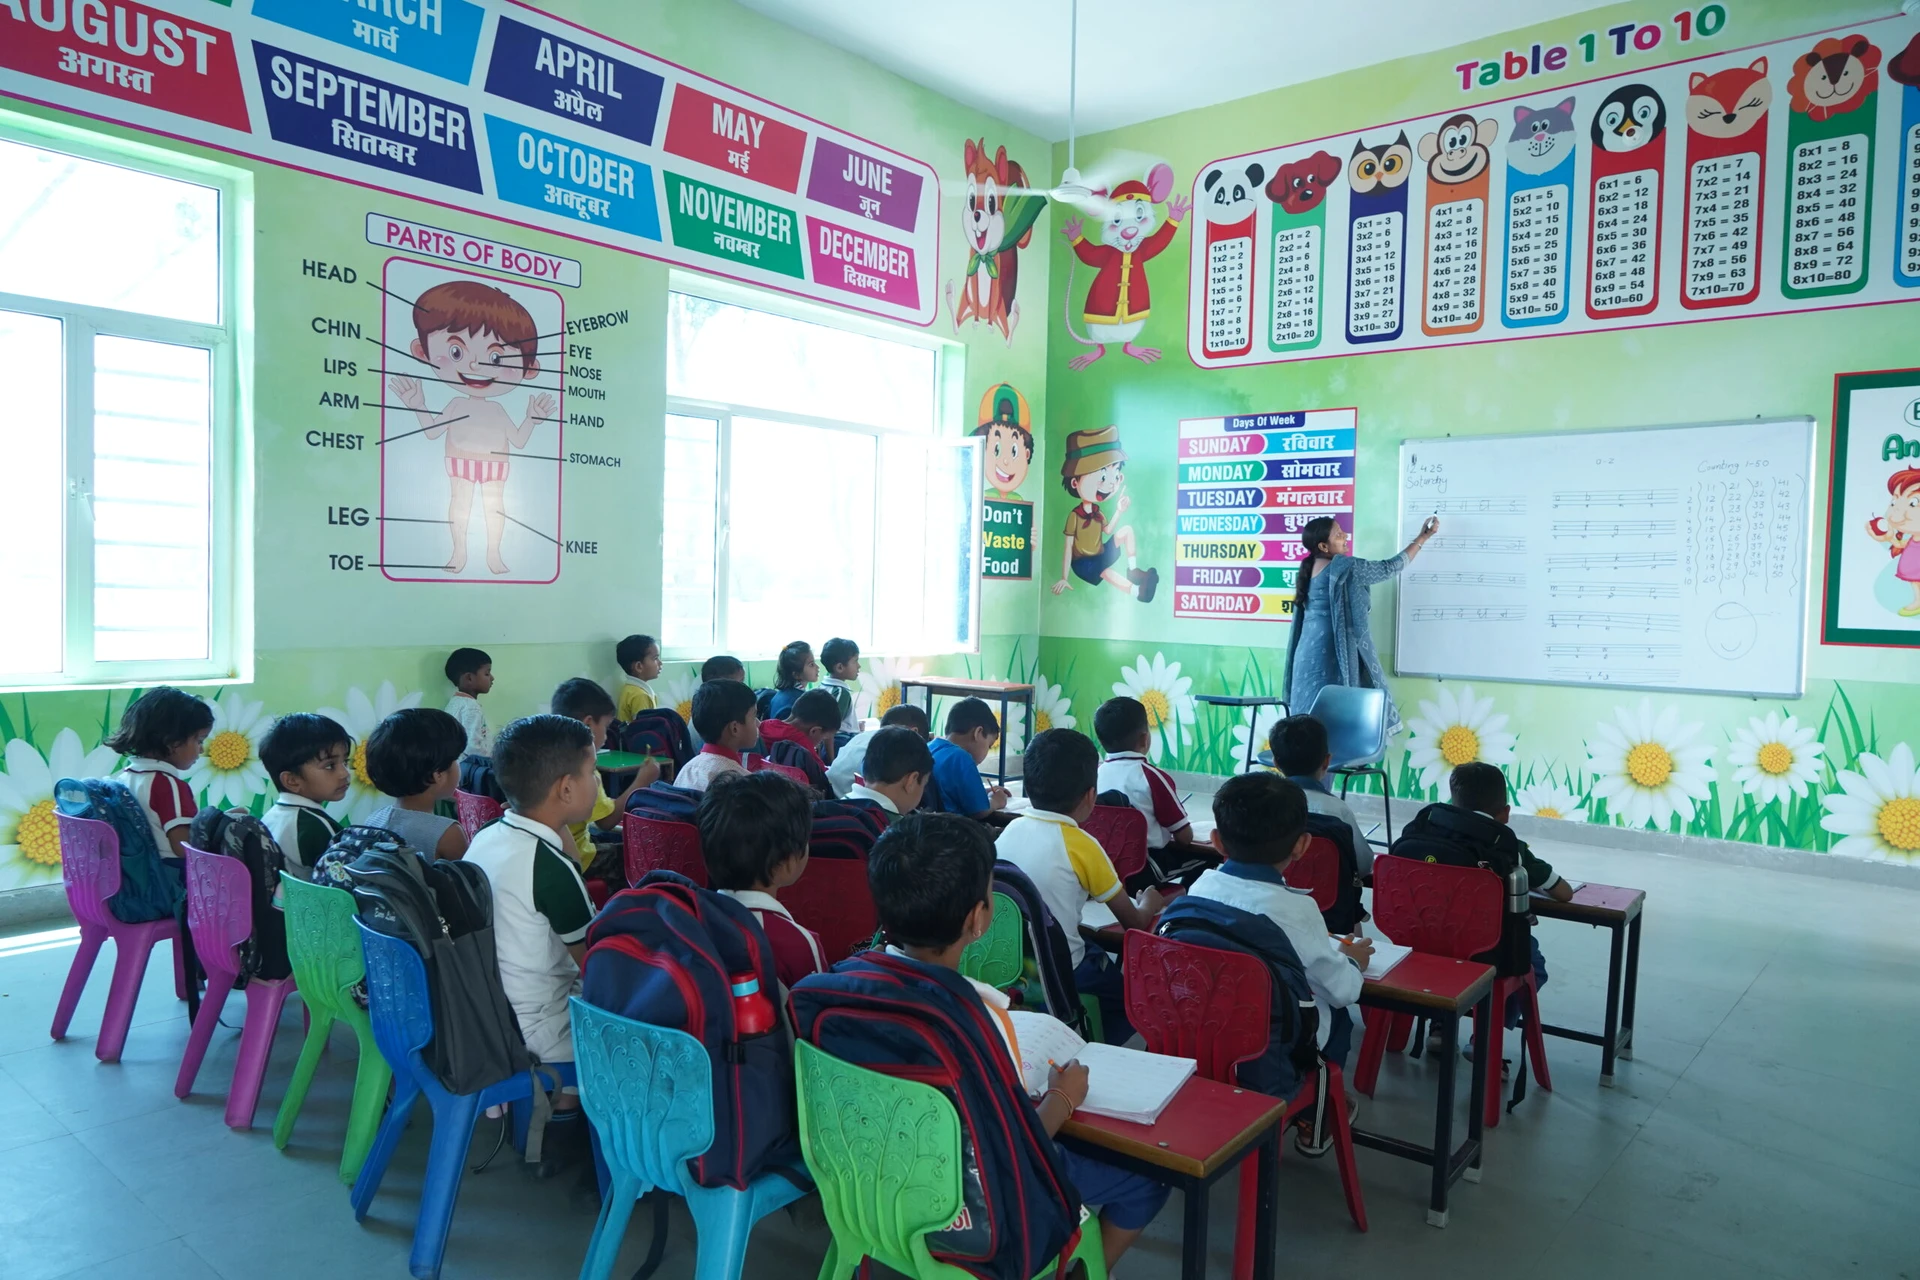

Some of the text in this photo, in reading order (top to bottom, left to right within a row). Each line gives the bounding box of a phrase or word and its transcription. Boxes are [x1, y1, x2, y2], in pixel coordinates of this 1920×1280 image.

[352, 18, 400, 54] मार्च
[1456, 5, 1726, 91] Table 1 To 10
[58, 45, 155, 95] अगस्त
[535, 38, 623, 100] APRIL
[271, 56, 467, 151] SEPTEMBER
[712, 102, 766, 150] MAY
[331, 119, 419, 167] सितम्बर
[518, 131, 635, 199] OCTOBER
[727, 149, 751, 175] मई
[1798, 160, 1822, 171] 8x2
[1842, 154, 1858, 164] 16
[842, 153, 893, 197] JUNE
[1696, 176, 1718, 187] 7x2
[1736, 171, 1750, 181] 14
[1599, 192, 1619, 203] 6x2
[1635, 187, 1648, 197] 12
[679, 181, 792, 245] NOVEMBER
[858, 194, 881, 219] जून
[1513, 206, 1532, 216] 5x2
[1547, 202, 1559, 211] 10
[1435, 219, 1452, 228] 4x2
[1466, 216, 1472, 224] 8
[1357, 231, 1373, 241] 3x2
[386, 222, 562, 279] PARTS OF BODY
[713, 231, 760, 260] नवम्बर
[819, 225, 909, 279] DECEMBER
[1279, 244, 1294, 253] 2x2
[1213, 254, 1227, 263] 1x2
[1794, 260, 1817, 270] 8x9
[1836, 255, 1853, 265] 72
[302, 259, 357, 283] HEAD
[843, 265, 886, 294] दिसम्बर
[1692, 272, 1713, 282] 7x9
[1731, 268, 1746, 278] 63
[1595, 284, 1615, 293] 6x9
[1630, 280, 1644, 289] 54
[1510, 294, 1528, 303] 5x9
[1542, 290, 1556, 299] 45
[1354, 312, 1370, 321] 3x9
[1382, 309, 1393, 318] 27
[1432, 303, 1449, 312] 4x9
[1463, 300, 1475, 309] 36
[311, 316, 361, 339] CHIN
[566, 310, 629, 336] EYEBROW
[1211, 329, 1225, 337] 1x9
[1236, 327, 1241, 335] 9
[1277, 321, 1291, 330] 2x9
[569, 345, 593, 360] EYE
[324, 358, 357, 377] LIPS
[570, 365, 602, 381] NOSE
[319, 391, 360, 410] ARM
[568, 385, 606, 401] MOUTH
[570, 413, 605, 429] HAND
[1233, 414, 1296, 429] Days Of Week
[305, 430, 364, 450] CHEST
[1189, 436, 1250, 454] SUNDAY
[1282, 434, 1336, 452] रविवार
[570, 453, 622, 468] STOMACH
[1281, 460, 1342, 479] सोमवार
[1697, 459, 1739, 475] Counting
[1188, 464, 1254, 482] MONDAY
[1187, 489, 1256, 506] TUESDAY
[1276, 487, 1346, 506] मंगलवार
[327, 506, 370, 526] LEG
[1181, 515, 1259, 532] WEDNESDAY
[566, 541, 598, 555] KNEE
[1183, 543, 1257, 559] THURSDAY
[329, 554, 364, 571] TOE
[982, 556, 1019, 574] Food
[1192, 569, 1243, 584] FRIDAY
[1181, 594, 1254, 612] SATURDAY
